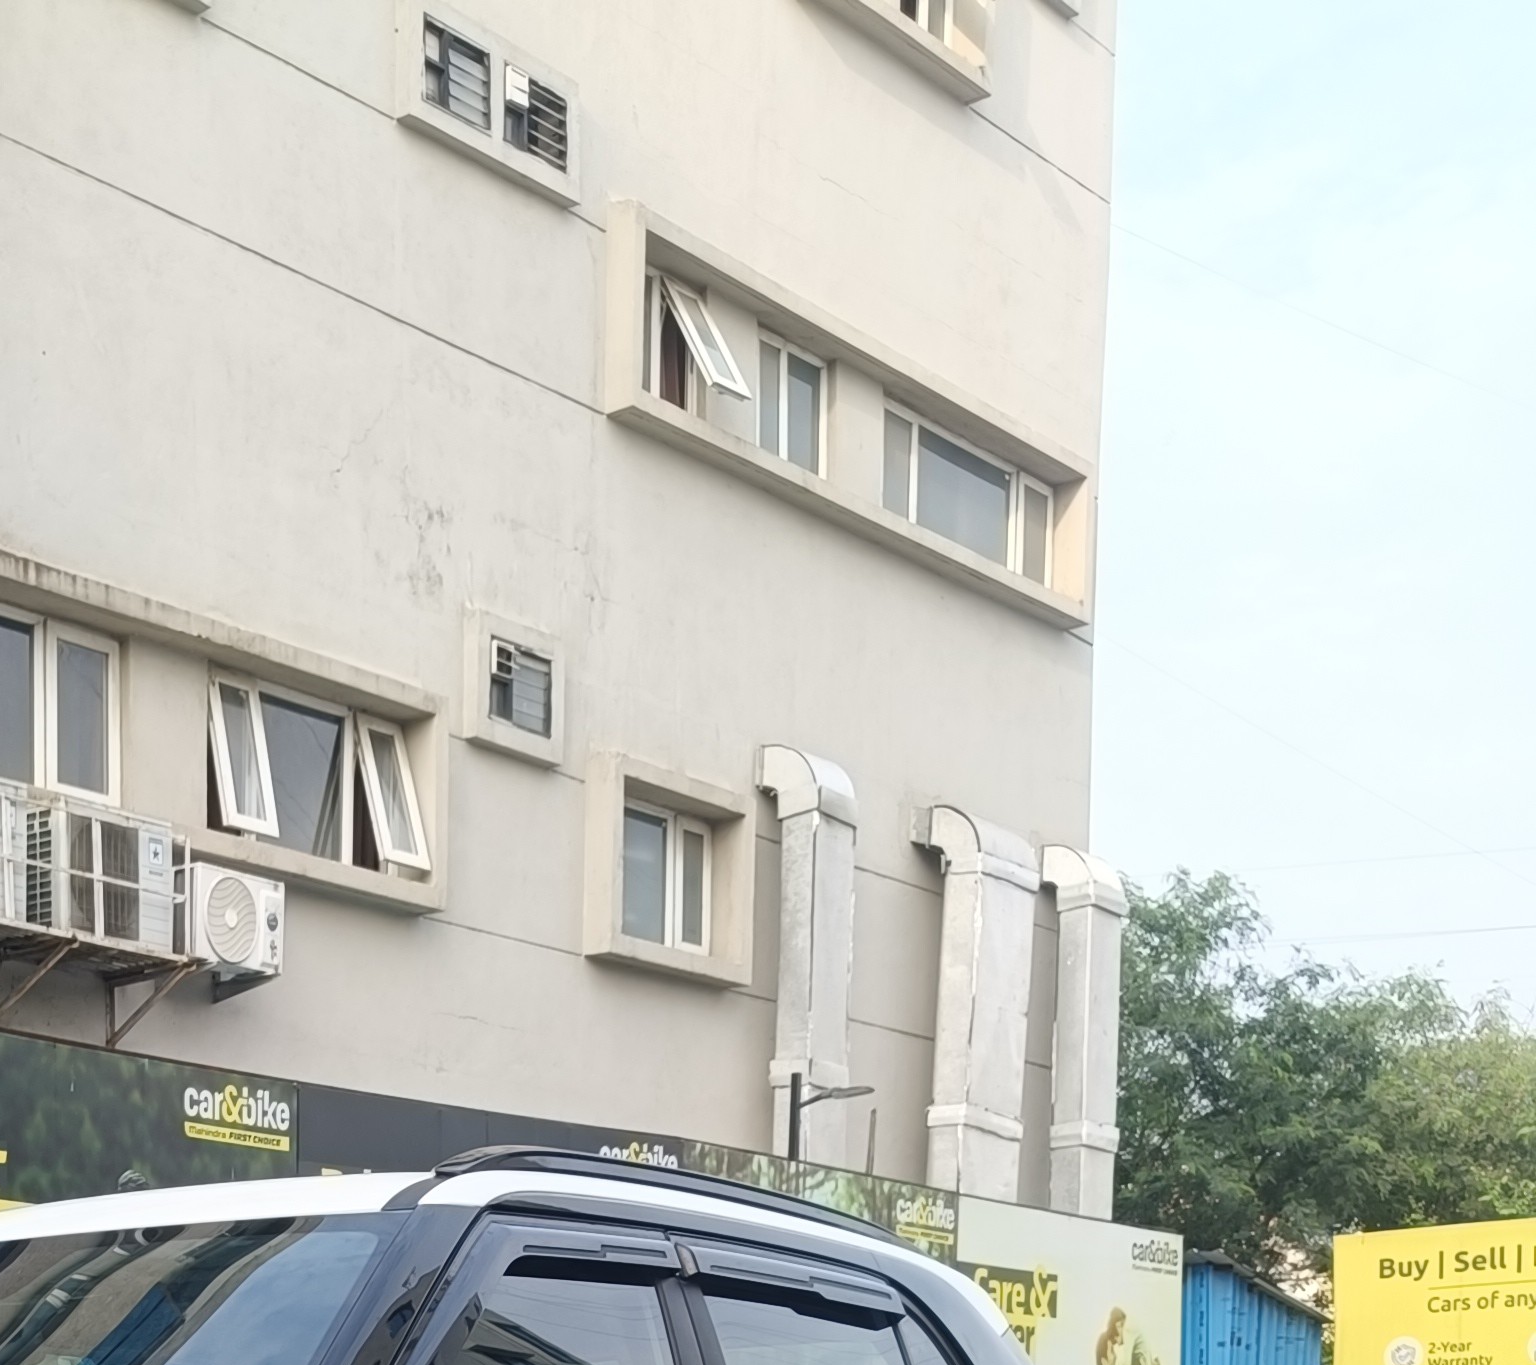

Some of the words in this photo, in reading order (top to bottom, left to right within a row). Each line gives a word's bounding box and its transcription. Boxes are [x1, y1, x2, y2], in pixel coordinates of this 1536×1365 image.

[184, 1084, 290, 1131] car&bike
[229, 1132, 251, 1142] FIRST
[252, 1135, 281, 1147] CHOICE
[1379, 1257, 1429, 1281] Buy
[1454, 1246, 1507, 1273] Sell
[1427, 1296, 1471, 1313] Cars
[1477, 1290, 1499, 1309] of
[1428, 1341, 1472, 1354] 2-Year
